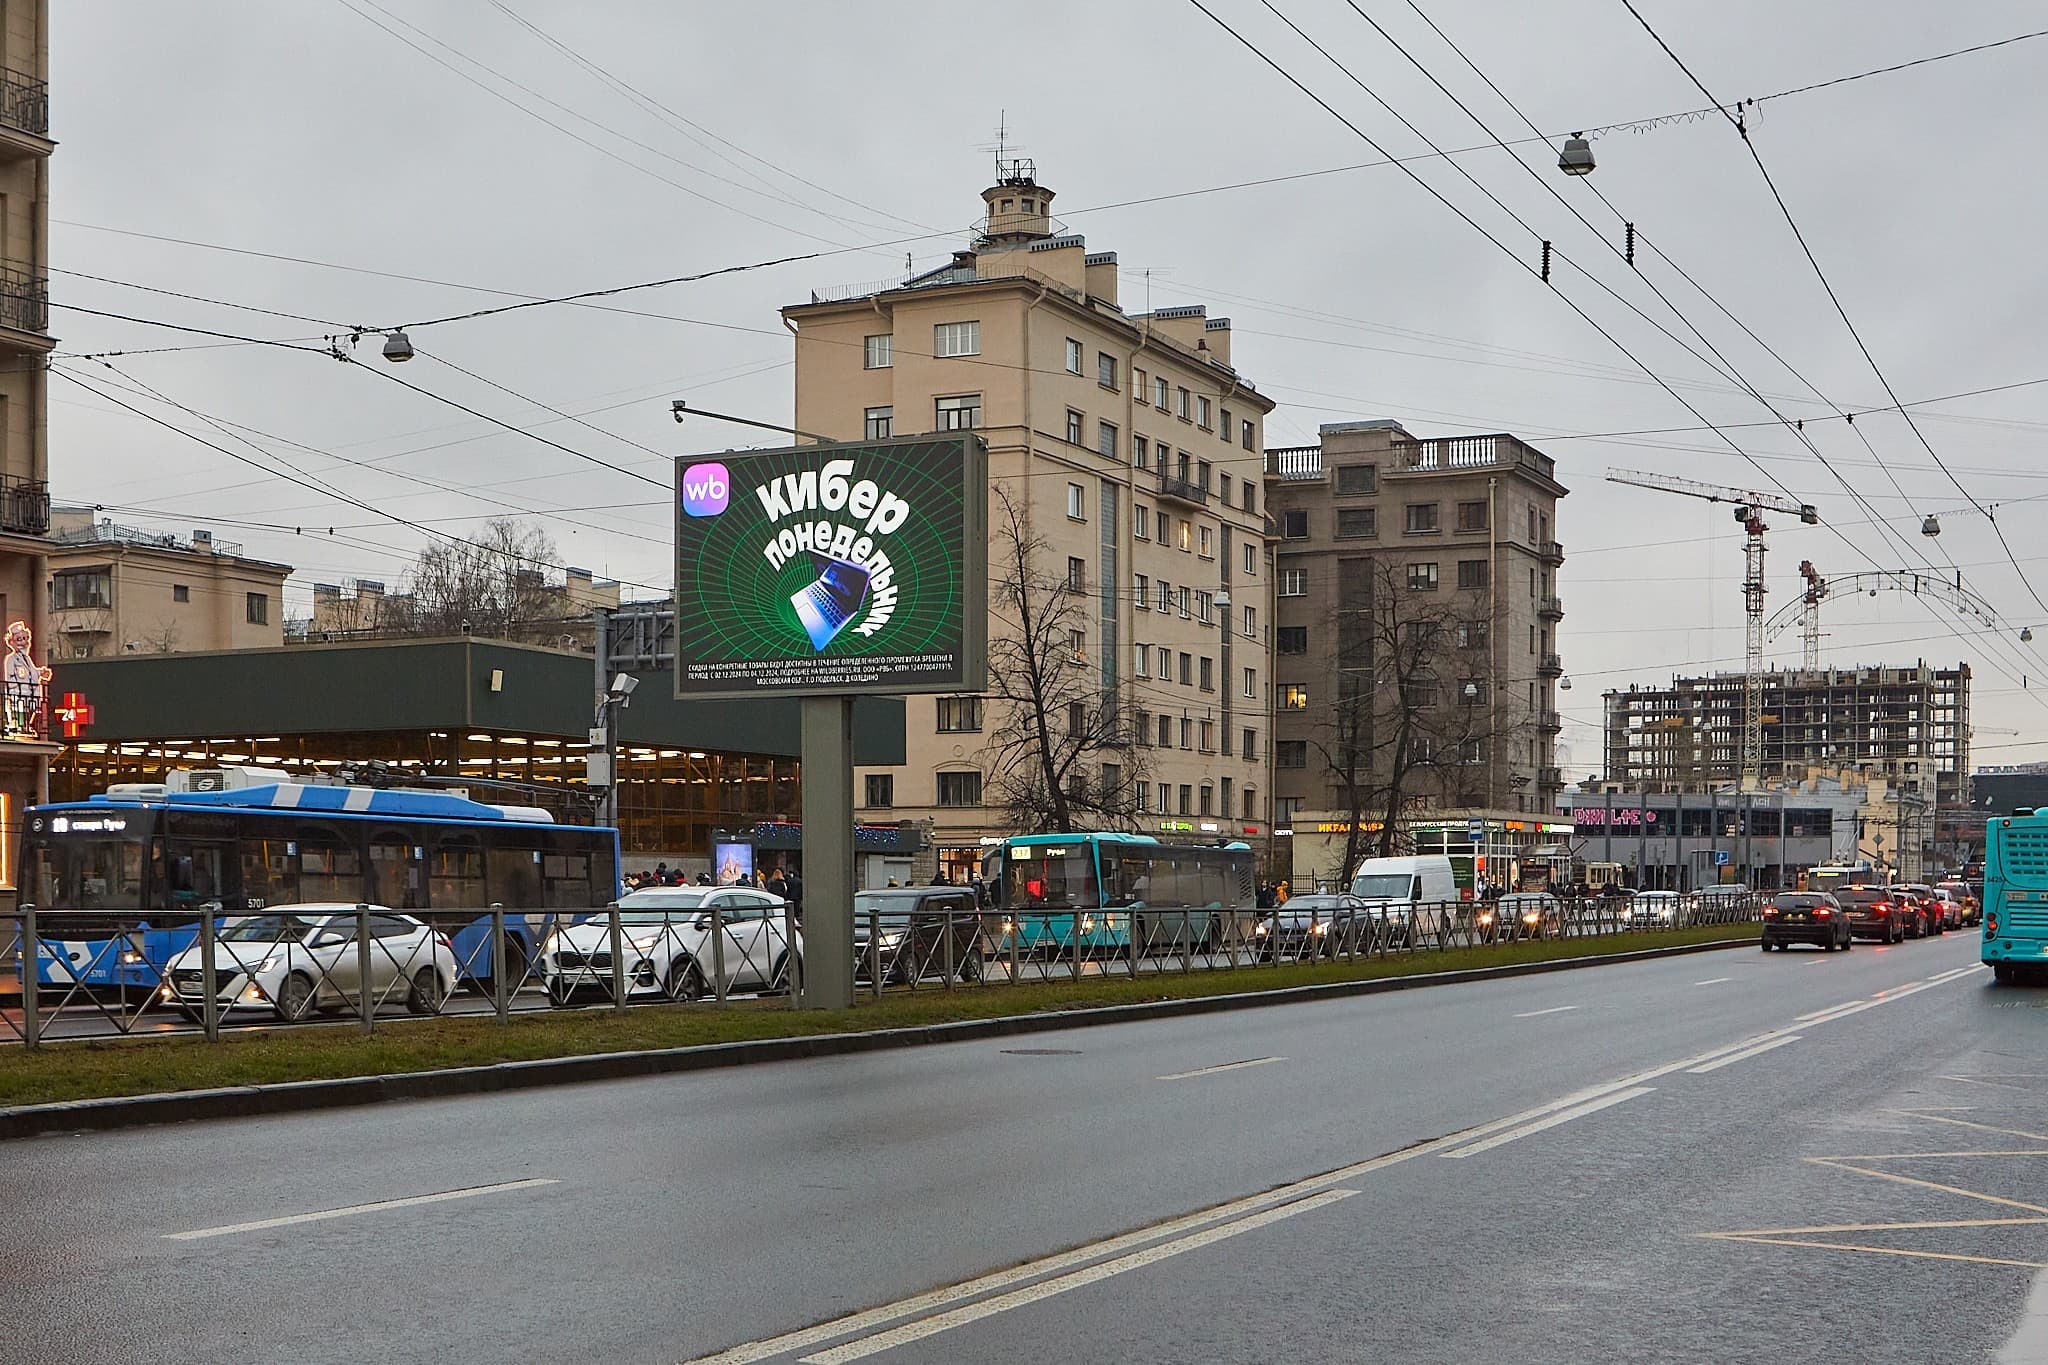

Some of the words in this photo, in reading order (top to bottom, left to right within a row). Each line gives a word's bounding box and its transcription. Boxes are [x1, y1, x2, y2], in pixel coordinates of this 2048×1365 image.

[686, 474, 726, 501] wb
[755, 459, 910, 536] кибер
[763, 520, 898, 638] понедельник
[62, 708, 76, 722] 24
[247, 898, 265, 909] 5701
[90, 969, 107, 978] 5701
